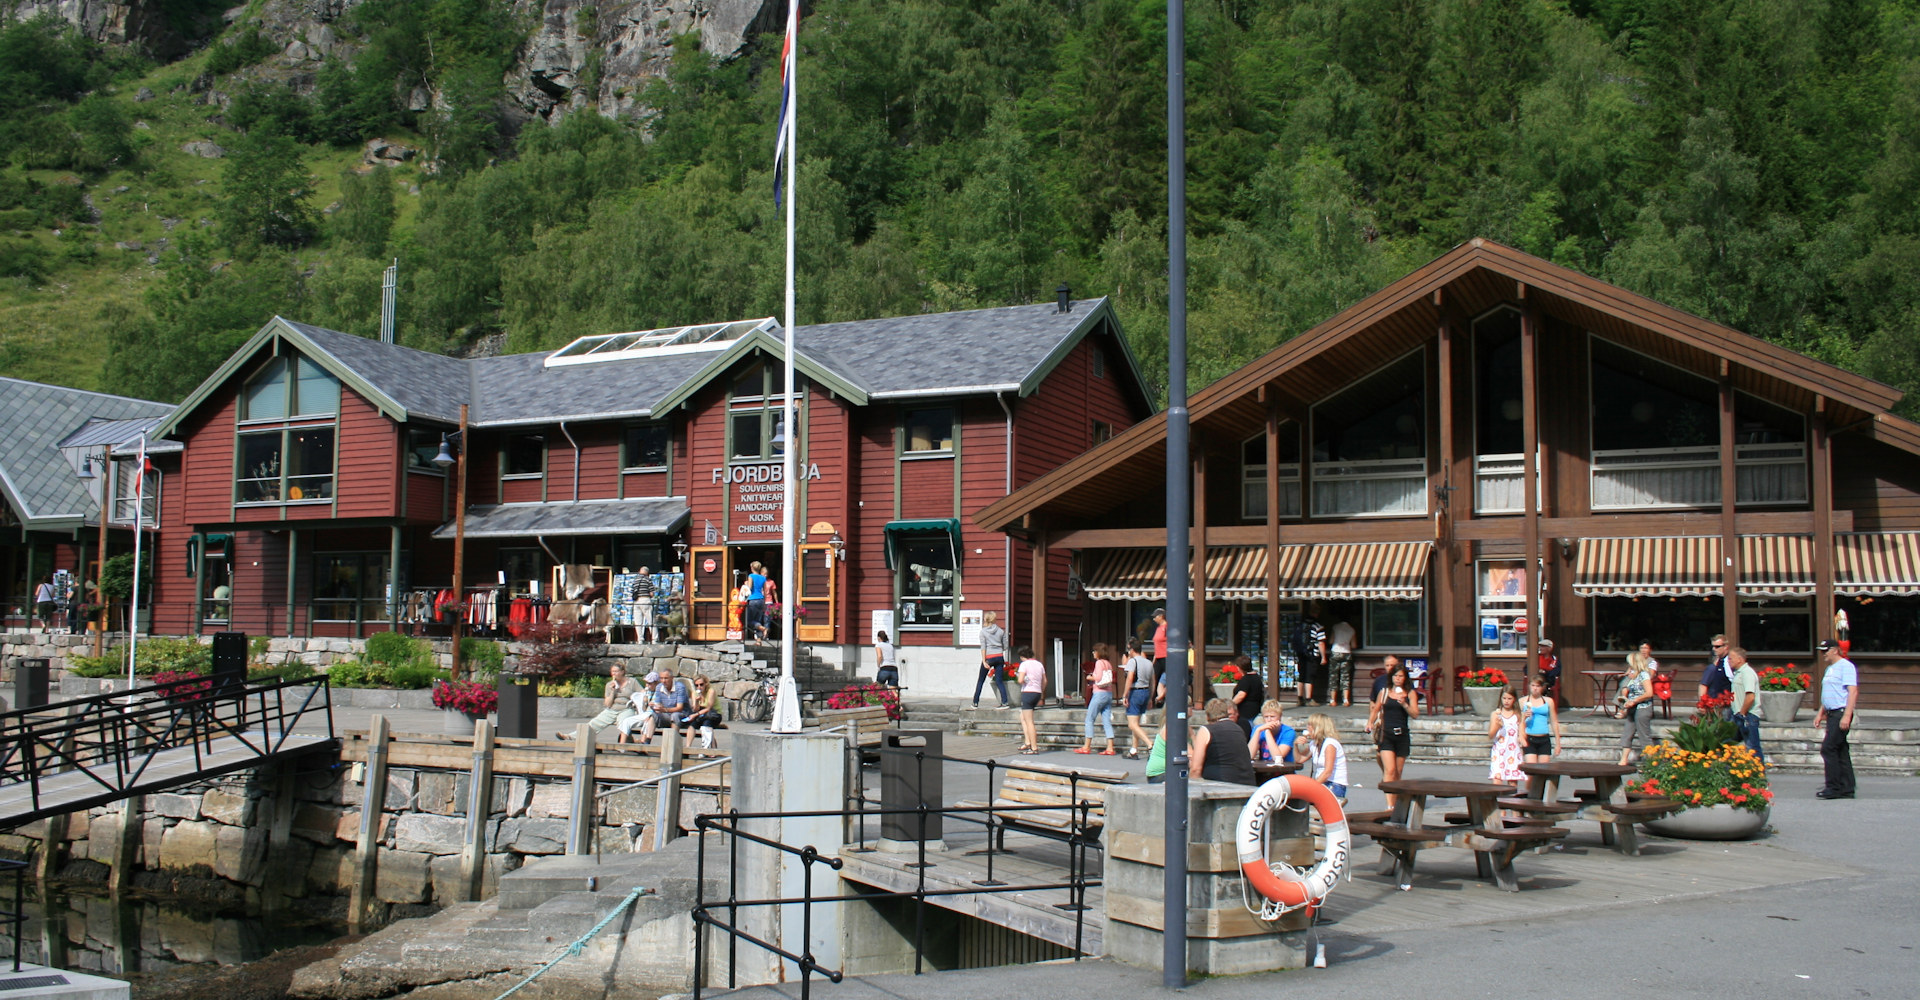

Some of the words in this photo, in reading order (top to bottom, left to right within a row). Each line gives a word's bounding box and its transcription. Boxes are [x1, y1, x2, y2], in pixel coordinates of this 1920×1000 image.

[712, 463, 821, 484] FJORDBDA
[739, 484, 784, 493] SOUVENIRS
[741, 493, 783, 502] KNITWEAR
[734, 502, 784, 512] HANDCRAFT
[749, 513, 775, 522] KIOSK
[738, 524, 784, 533] CHRISTMAS
[1248, 794, 1275, 842] vesta
[1323, 840, 1347, 887] vesta
